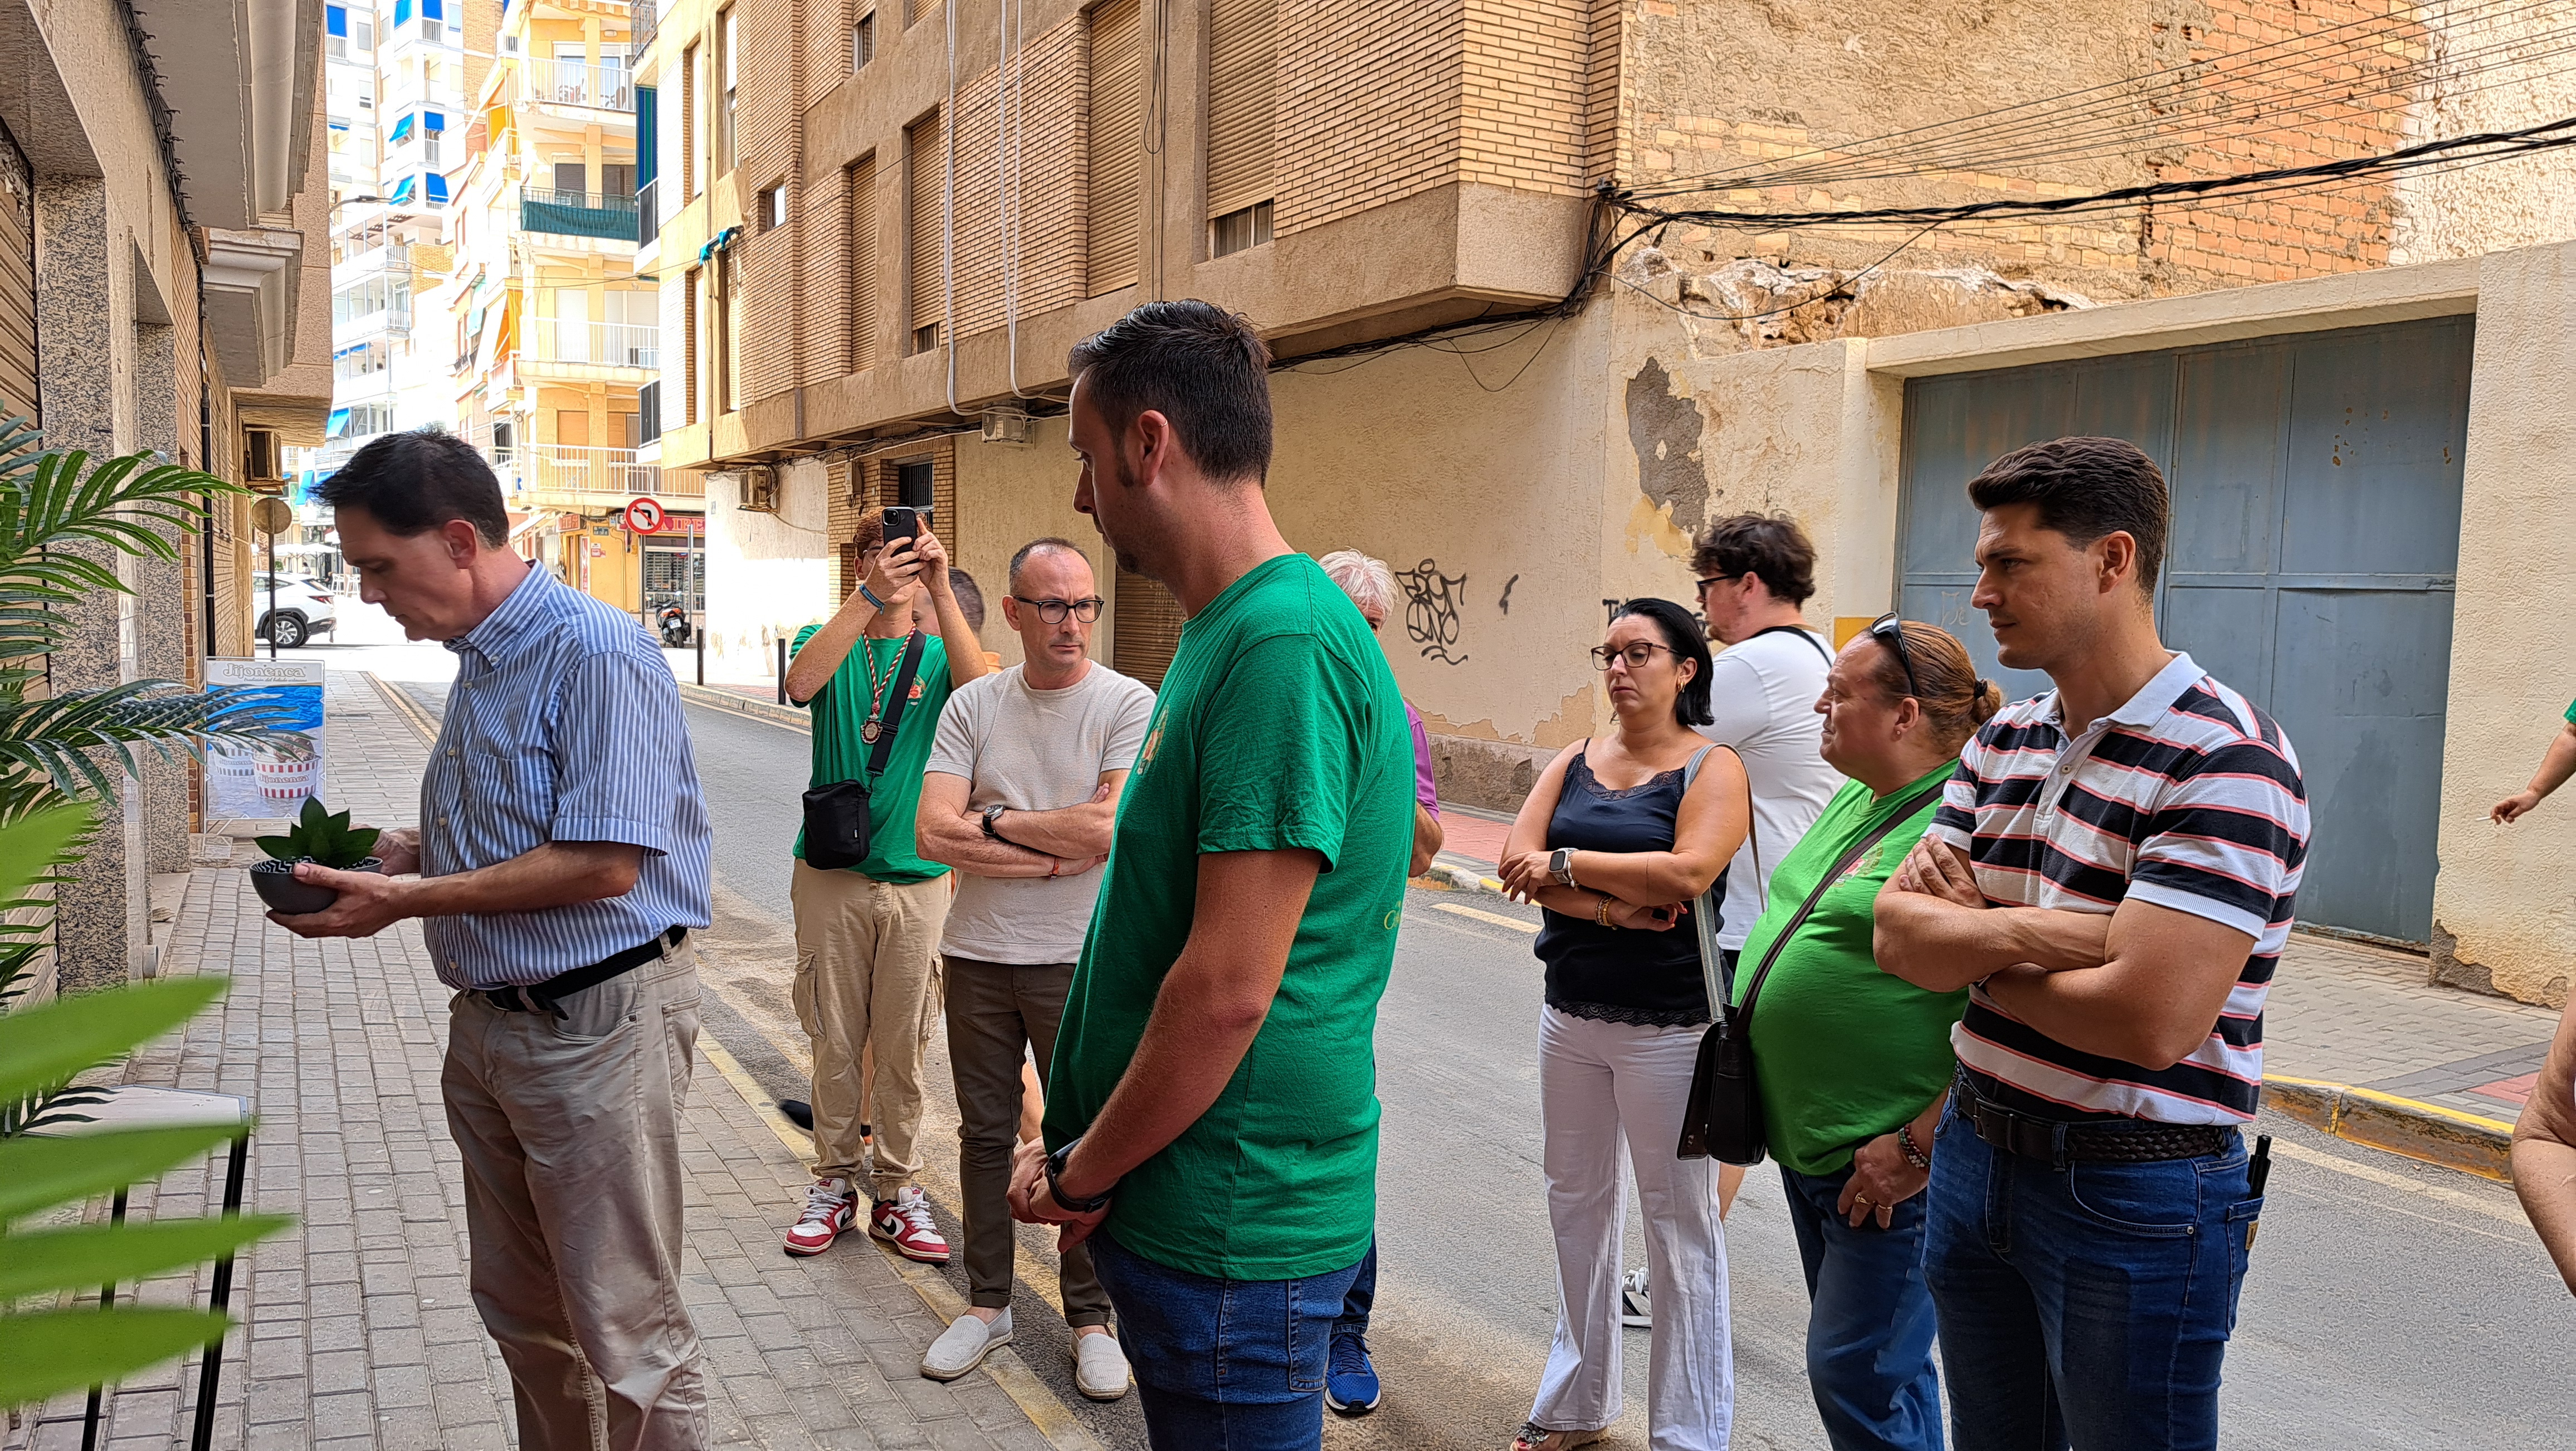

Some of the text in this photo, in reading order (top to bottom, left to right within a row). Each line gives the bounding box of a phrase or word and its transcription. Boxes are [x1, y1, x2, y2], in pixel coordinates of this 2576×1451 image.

[672, 518, 705, 532] IBE
[223, 663, 306, 679] Jijonenca
[258, 773, 309, 783] Jijonenca
